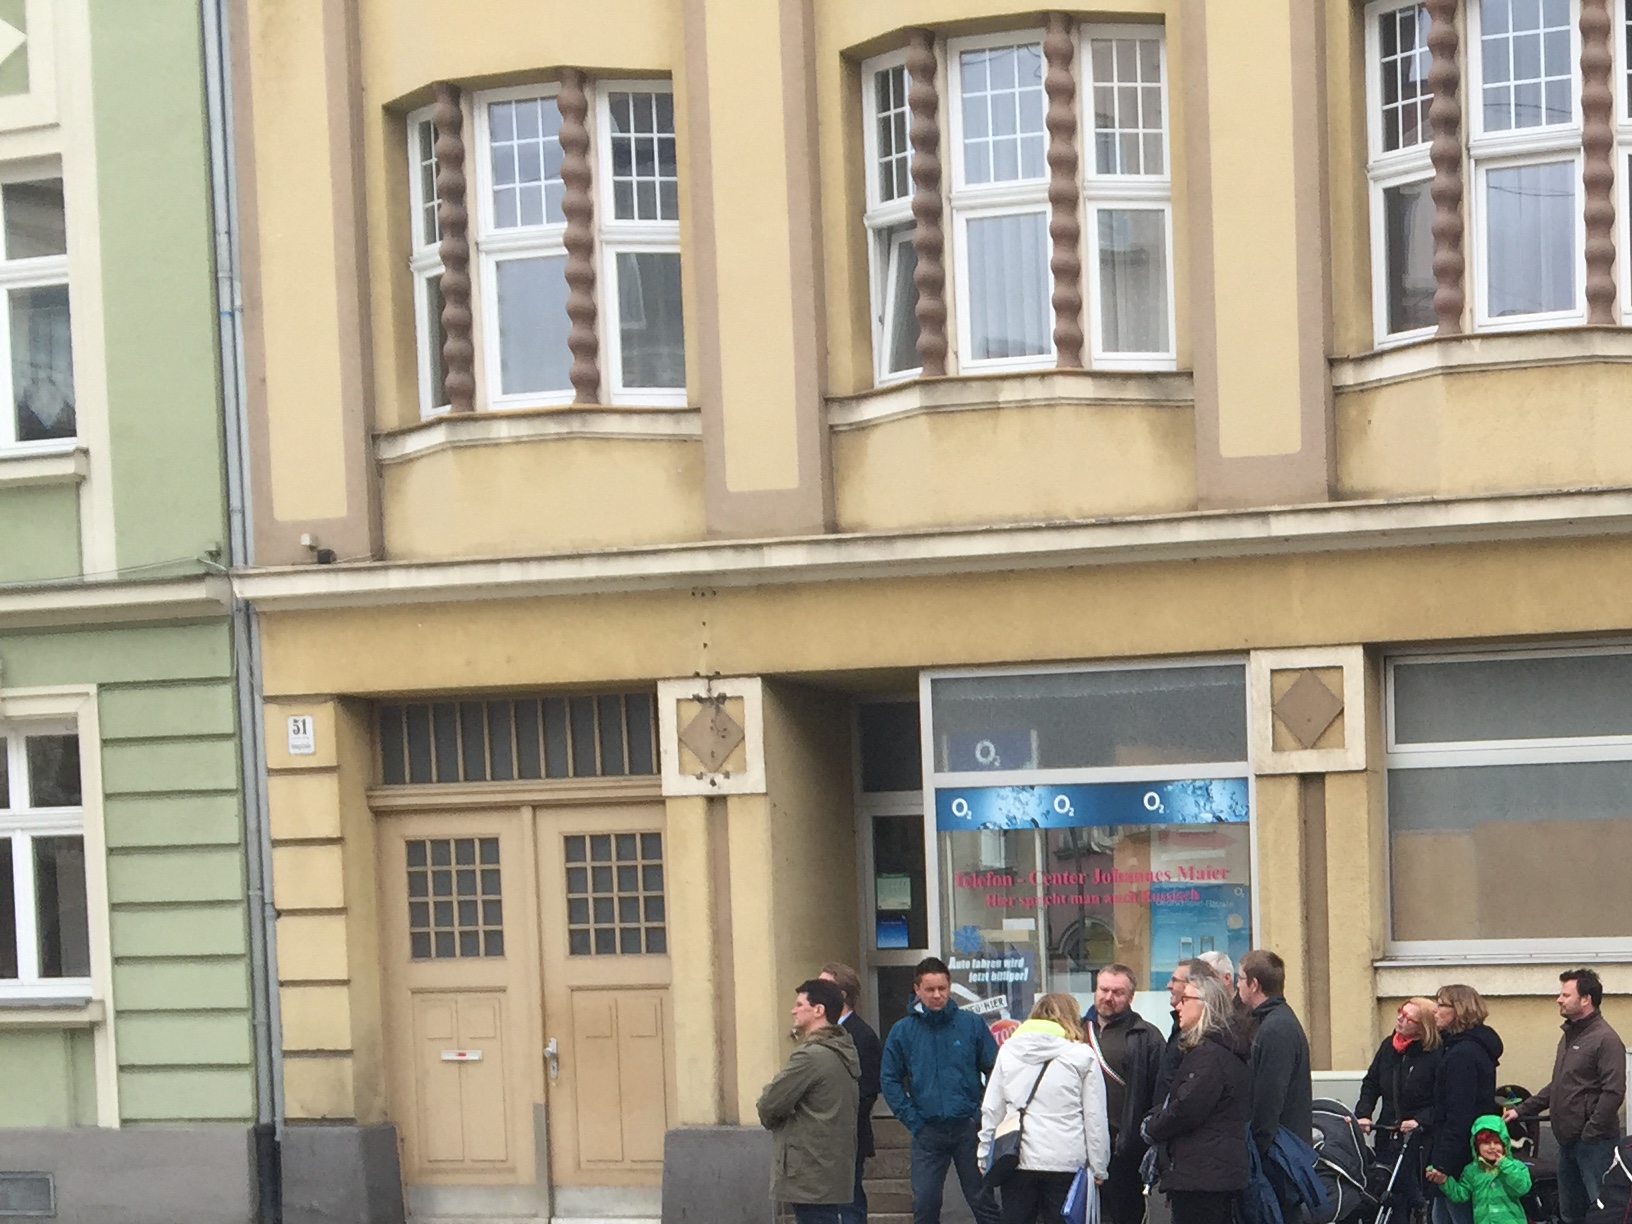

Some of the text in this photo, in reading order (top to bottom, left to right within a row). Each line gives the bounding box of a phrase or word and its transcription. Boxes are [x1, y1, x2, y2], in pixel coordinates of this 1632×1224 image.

[292, 718, 307, 735] 51
[954, 871, 1013, 889] Telefon
[1028, 870, 1087, 887] Center
[1093, 866, 1172, 885] Johannes
[1177, 864, 1230, 881] Maier
[1070, 893, 1101, 905] man
[948, 956, 971, 970] Auto
